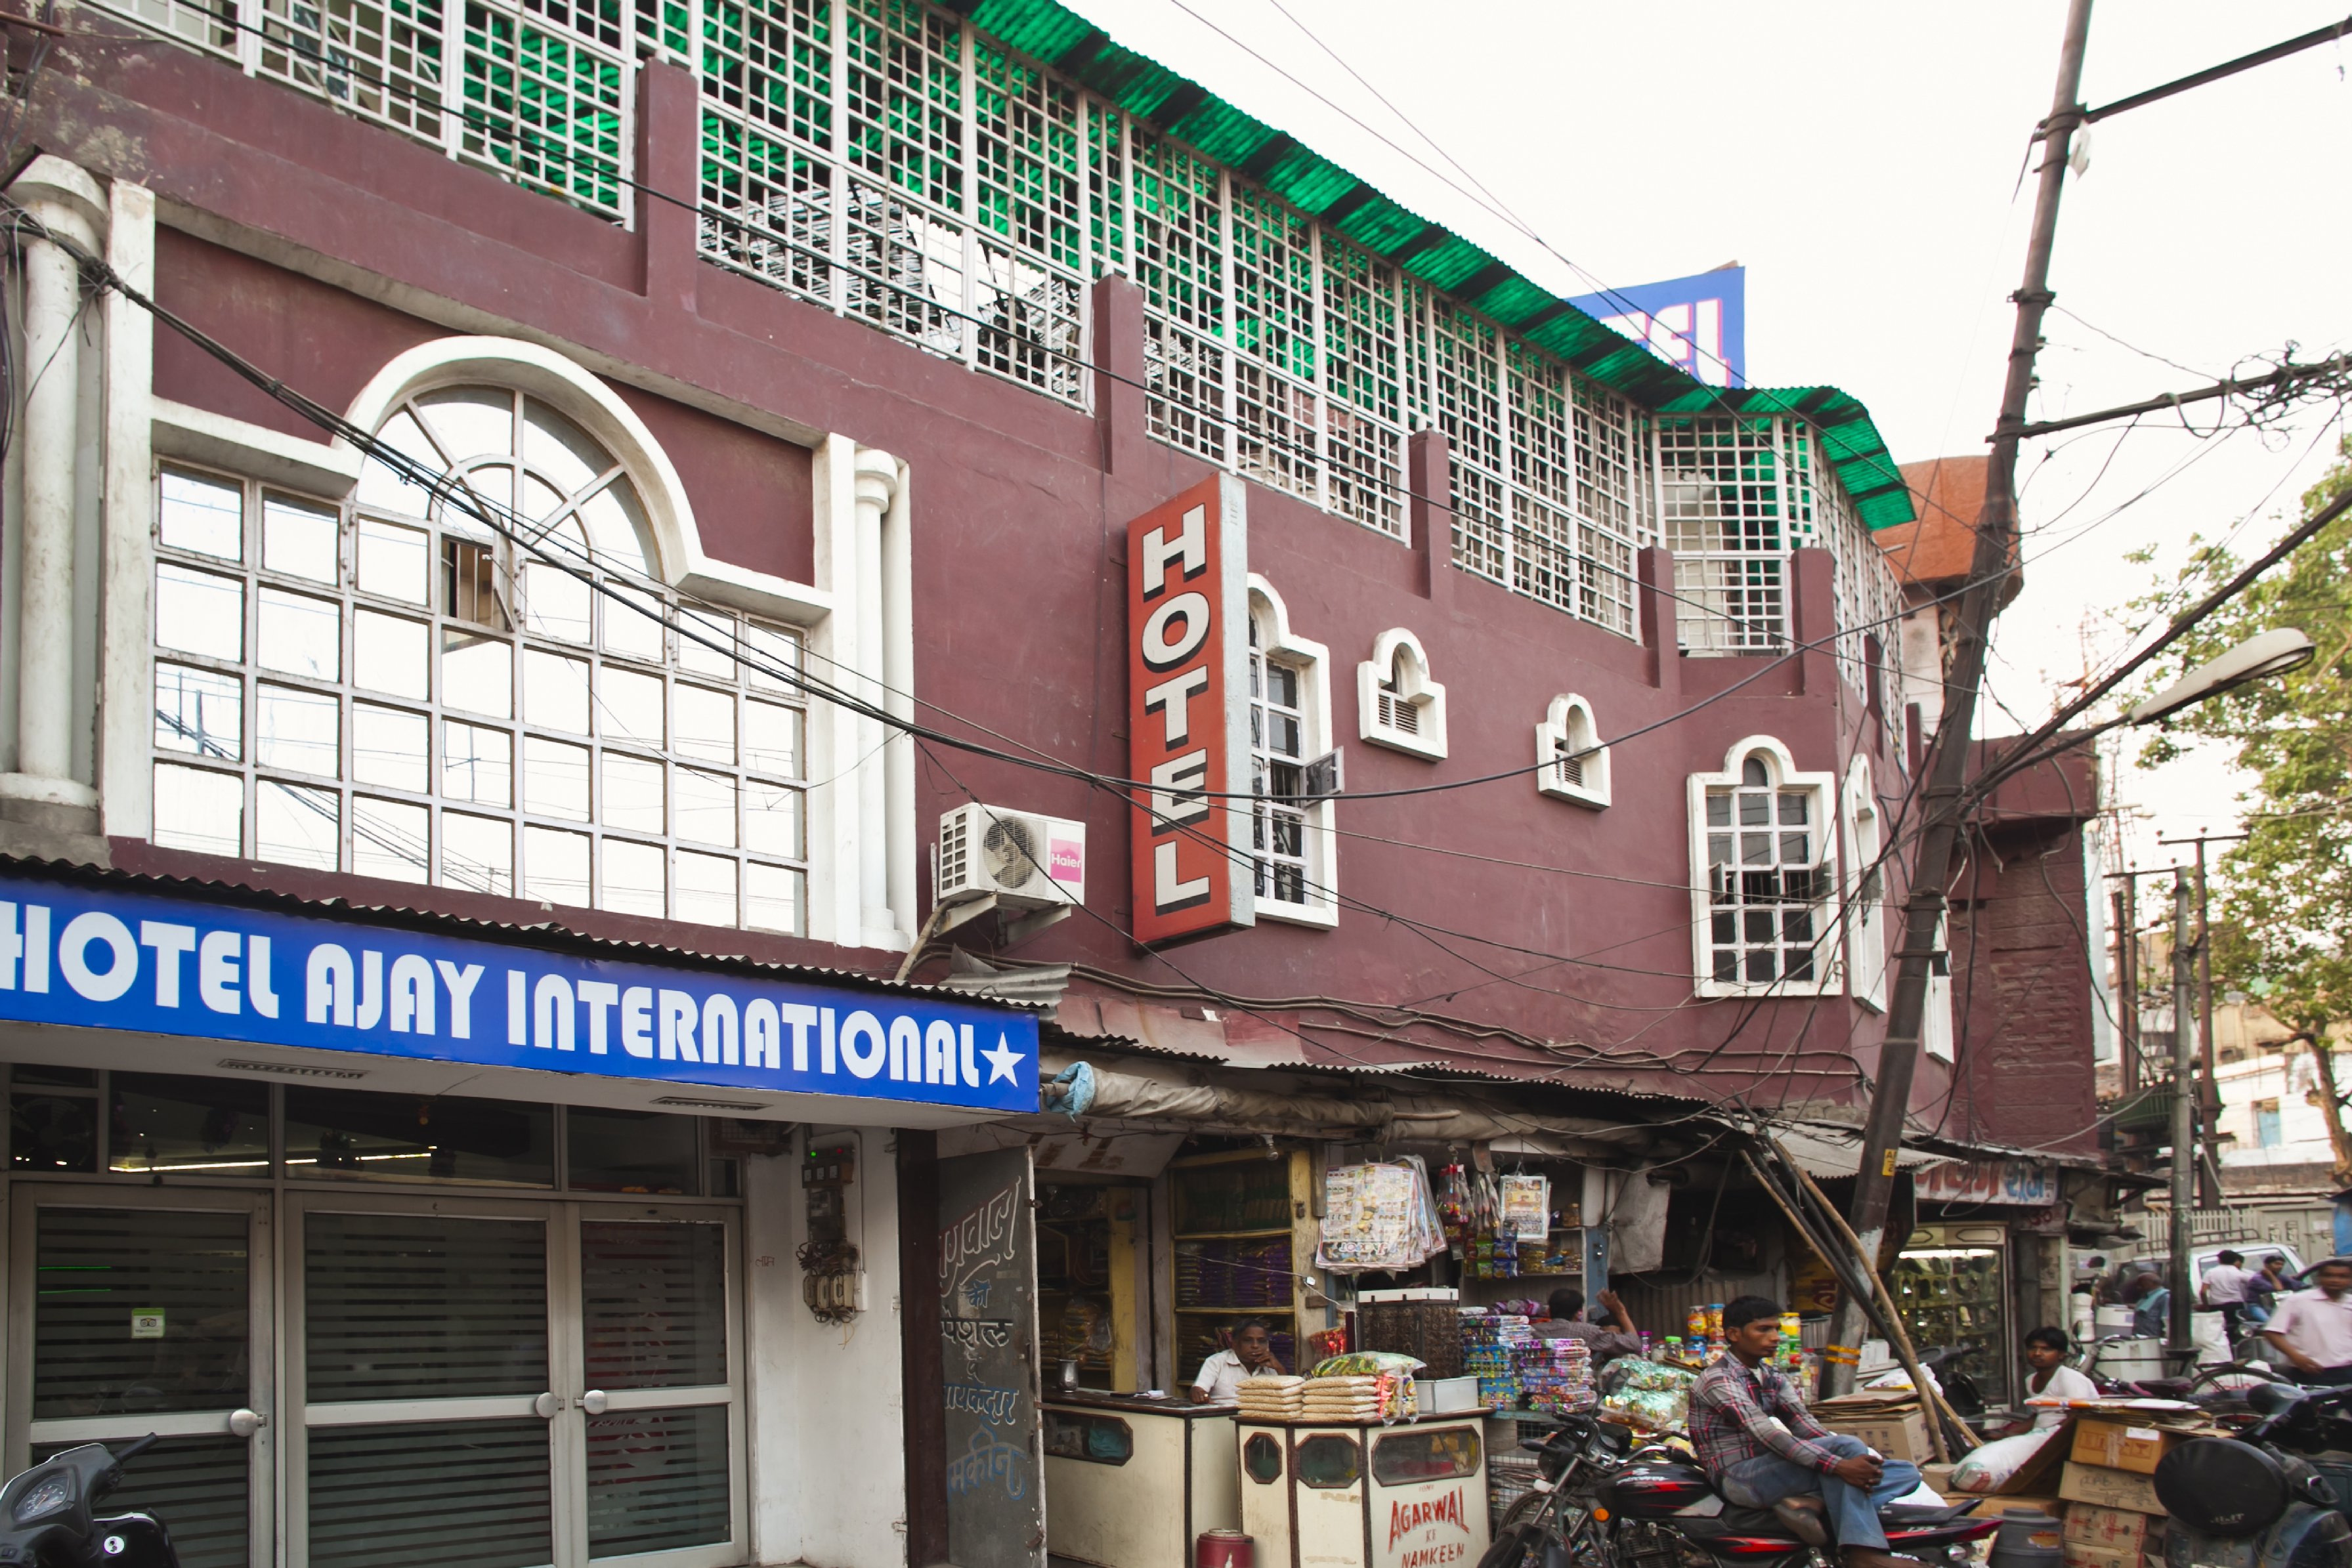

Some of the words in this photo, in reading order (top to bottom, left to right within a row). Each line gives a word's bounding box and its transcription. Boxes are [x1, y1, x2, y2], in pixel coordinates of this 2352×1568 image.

[1142, 503, 1210, 916] HOTEL
[1052, 854, 1081, 868] Haier
[0, 901, 279, 1019] HOTEL
[306, 943, 486, 1040] AJAY
[507, 970, 979, 1088] INTERNATIONAL
[1388, 1486, 1470, 1554] AGARWAL
[1401, 1542, 1465, 1568] NAMKEEN
